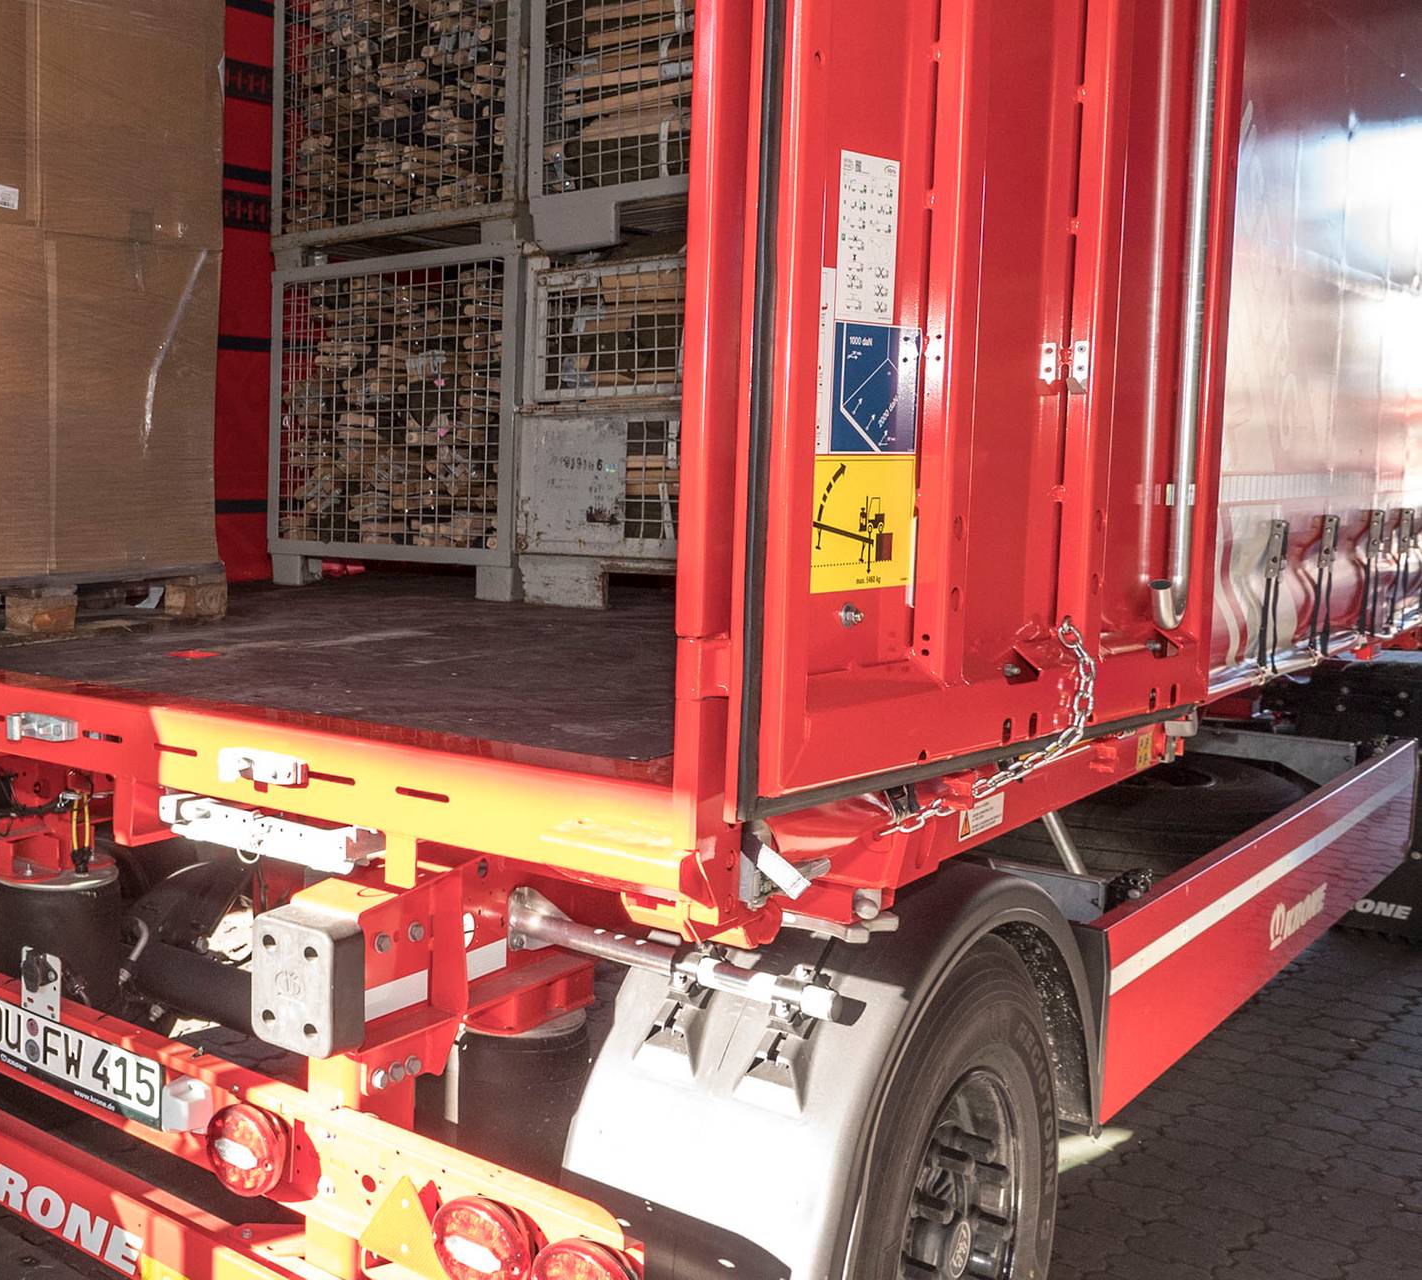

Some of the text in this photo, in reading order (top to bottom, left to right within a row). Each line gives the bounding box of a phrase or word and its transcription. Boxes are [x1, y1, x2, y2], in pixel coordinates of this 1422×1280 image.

[1352, 899, 1412, 920] ONE
[43, 1026, 83, 1079] FW
[92, 1049, 155, 1107] 415
